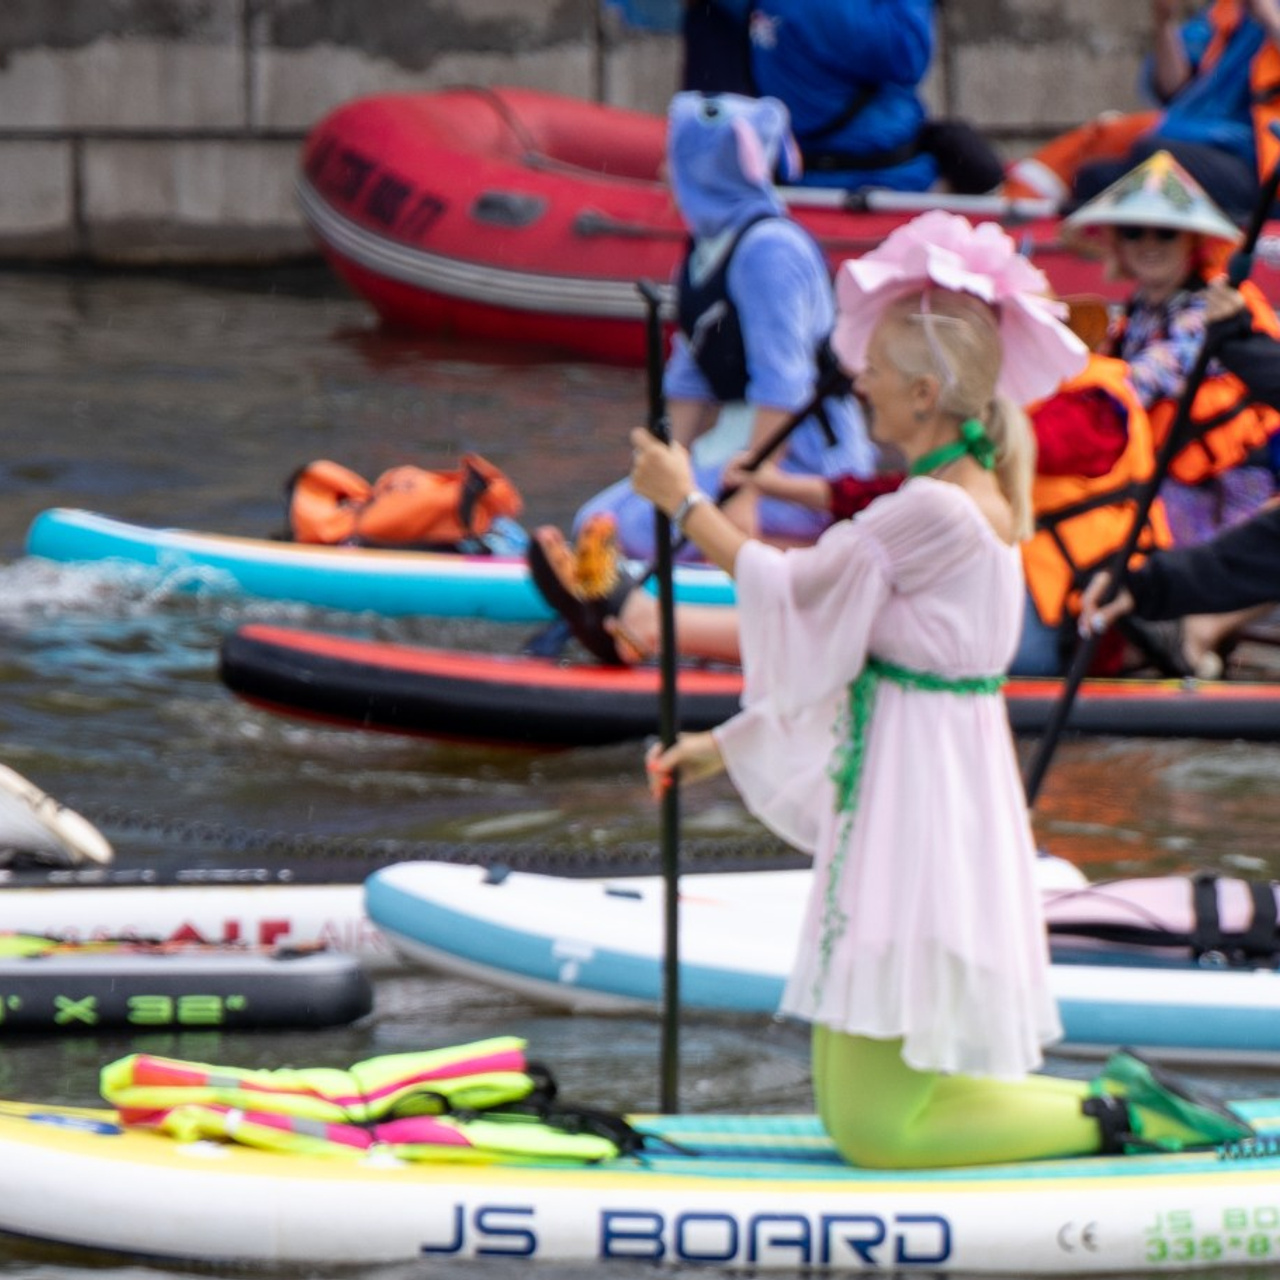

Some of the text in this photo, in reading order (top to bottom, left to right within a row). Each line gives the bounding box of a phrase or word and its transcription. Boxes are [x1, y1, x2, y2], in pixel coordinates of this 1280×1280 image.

[420, 1204, 952, 1266] JS BOARD
[1146, 1209, 1195, 1236] JS
